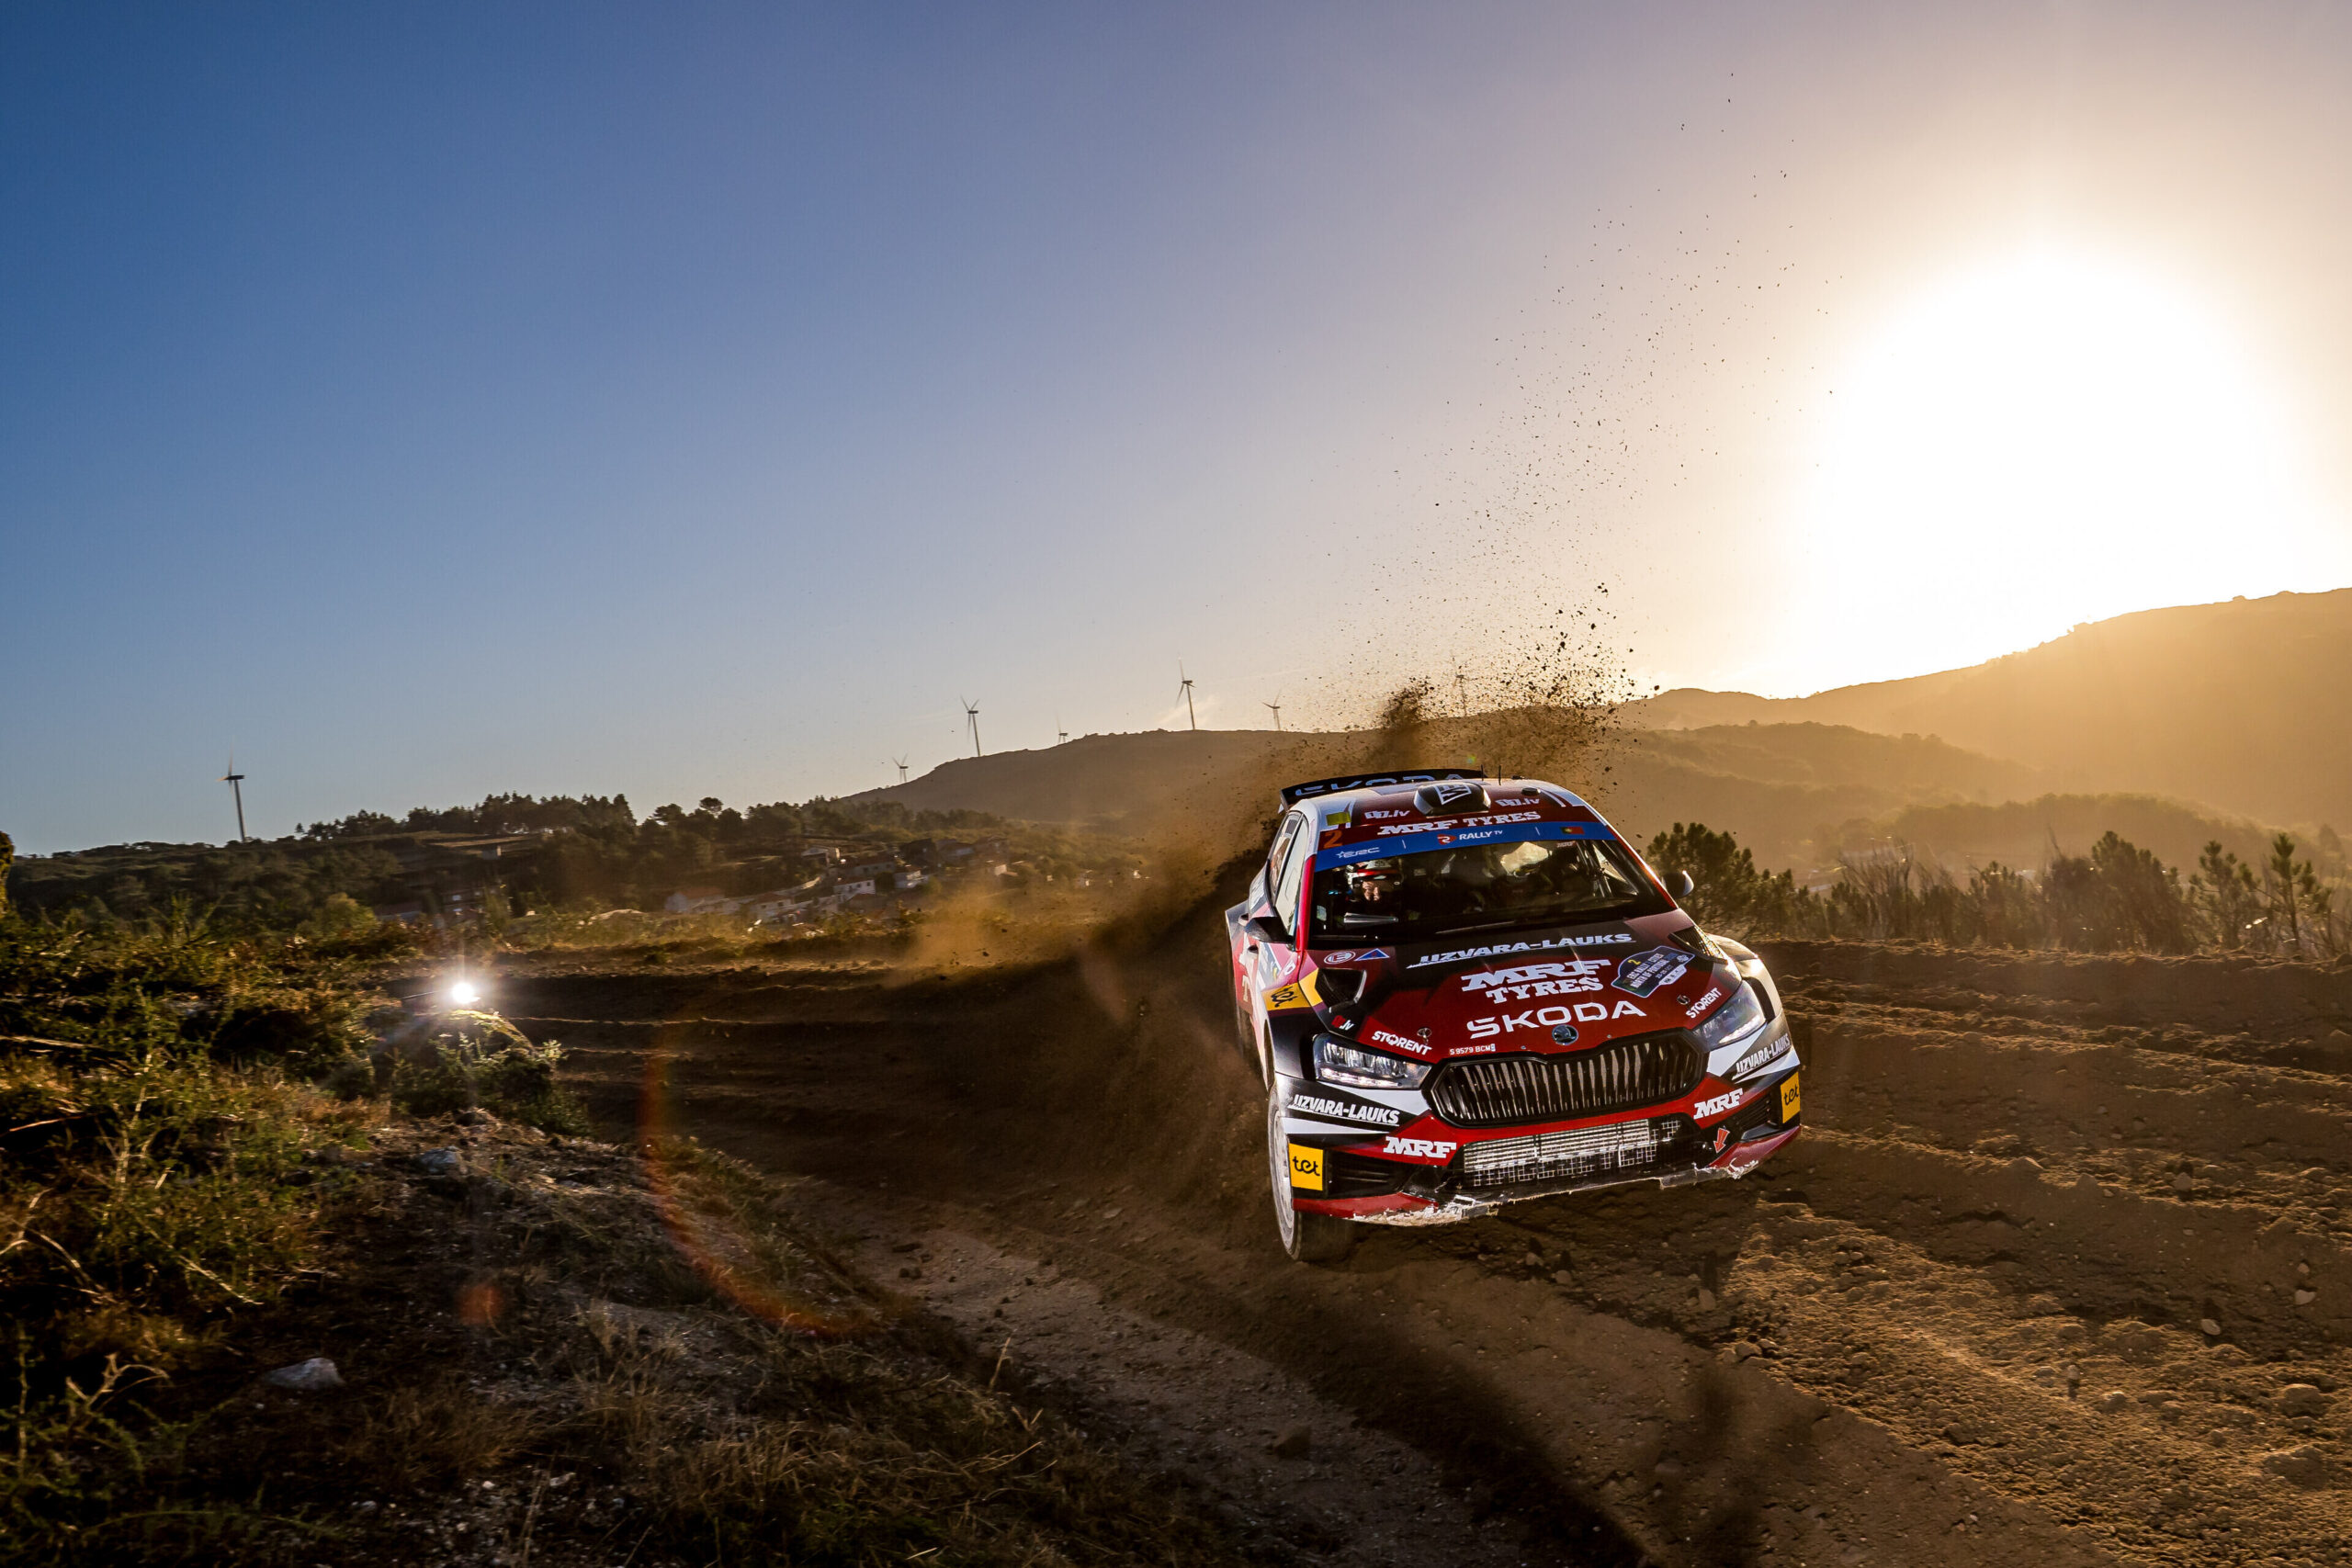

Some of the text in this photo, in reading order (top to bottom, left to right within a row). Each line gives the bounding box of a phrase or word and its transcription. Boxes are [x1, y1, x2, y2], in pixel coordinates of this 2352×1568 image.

[1377, 811, 1542, 835] MRF TYRES
[1459, 831, 1493, 840] RALLY
[1323, 830, 1343, 849] 2
[1342, 847, 1380, 859] ERC
[1415, 933, 1634, 966] UZVARA-LAUKS
[1461, 960, 1611, 992] MRF
[1486, 977, 1604, 1004] TYRES
[1685, 987, 1723, 1019] STORENT
[1467, 1000, 1647, 1040] SKODA
[1372, 1031, 1432, 1055] STORENT
[1735, 1033, 1791, 1077] UZVARA-LAUKS
[1693, 1088, 1744, 1120] MRF
[1783, 1085, 1799, 1106] tet
[1289, 1094, 1400, 1125] UZVARA-LAUKS
[1383, 1135, 1457, 1158] MRF
[1292, 1156, 1321, 1177] tet
